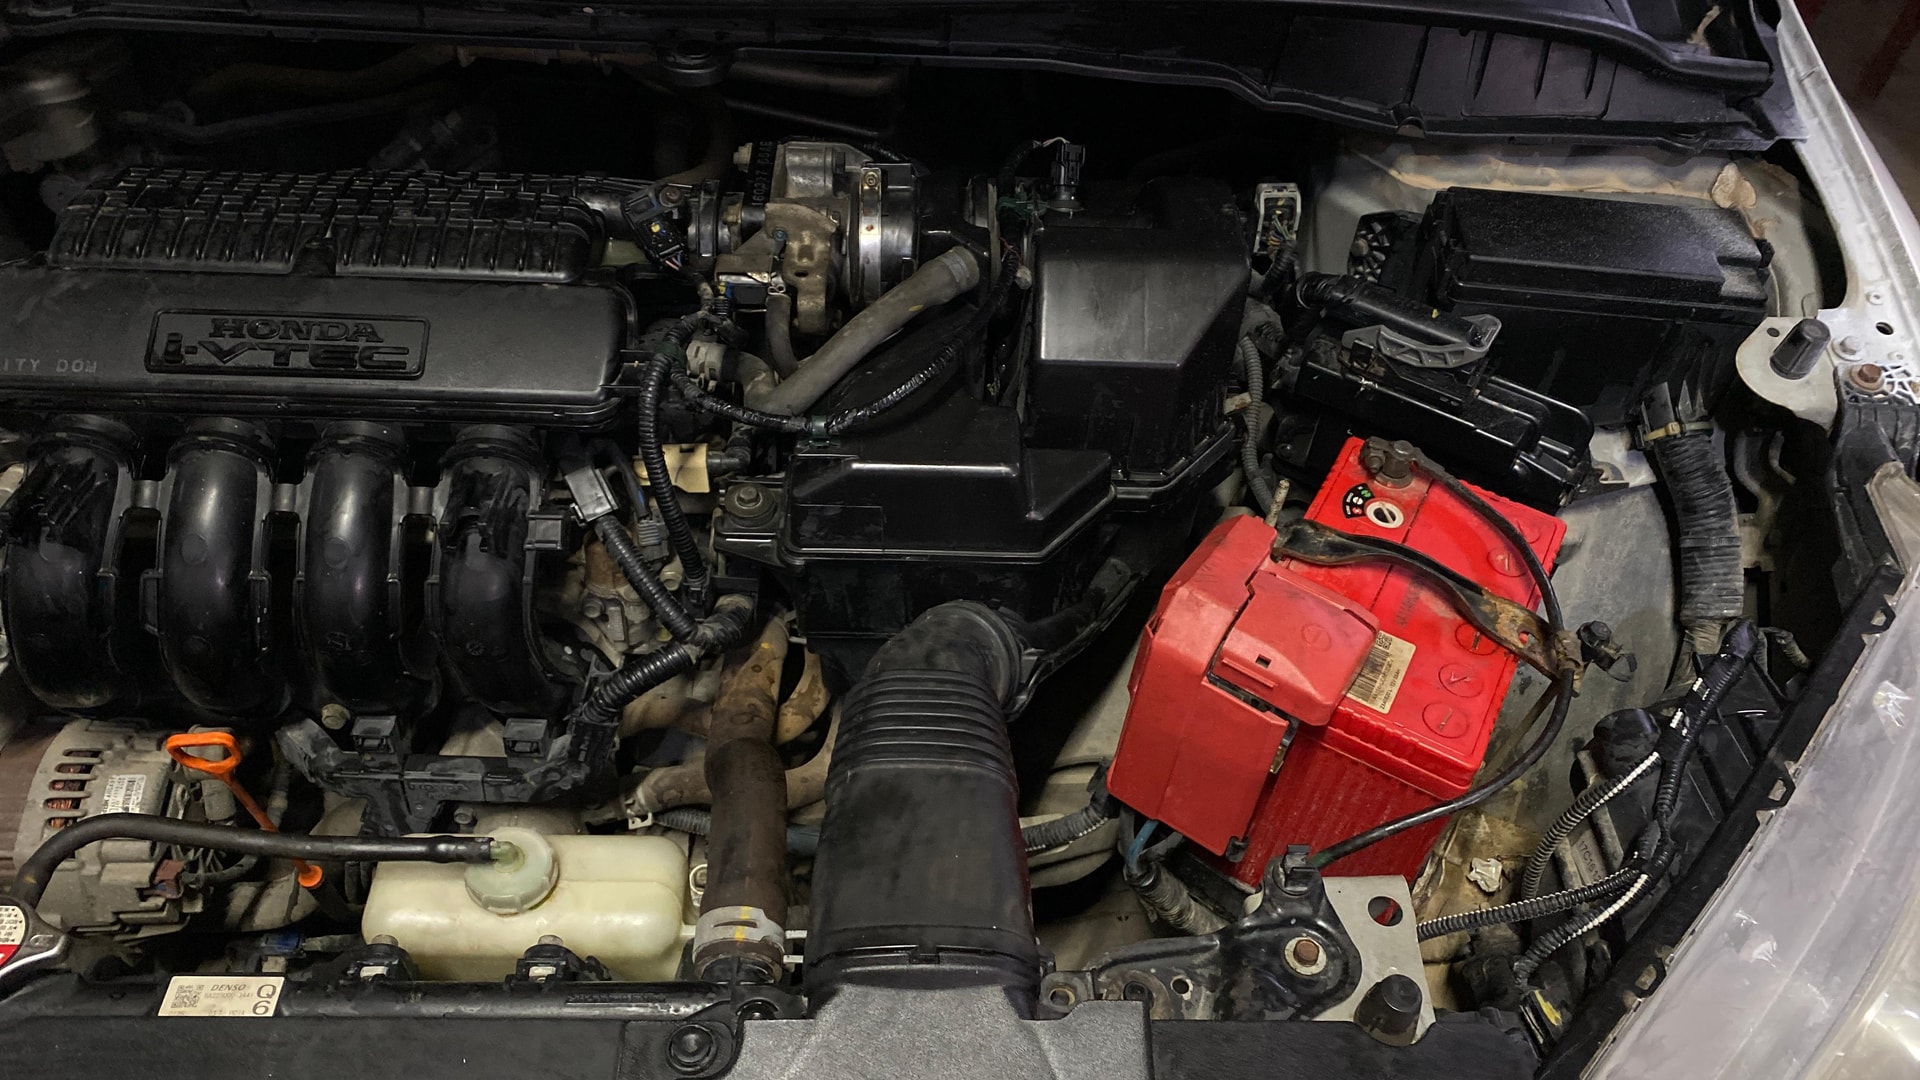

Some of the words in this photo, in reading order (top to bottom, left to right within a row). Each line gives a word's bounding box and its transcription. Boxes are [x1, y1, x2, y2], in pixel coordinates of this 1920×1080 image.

[208, 318, 384, 343] HONDA
[163, 333, 410, 371] i-VTEC
[256, 984, 277, 999] Q
[252, 1000, 271, 1015] 6
